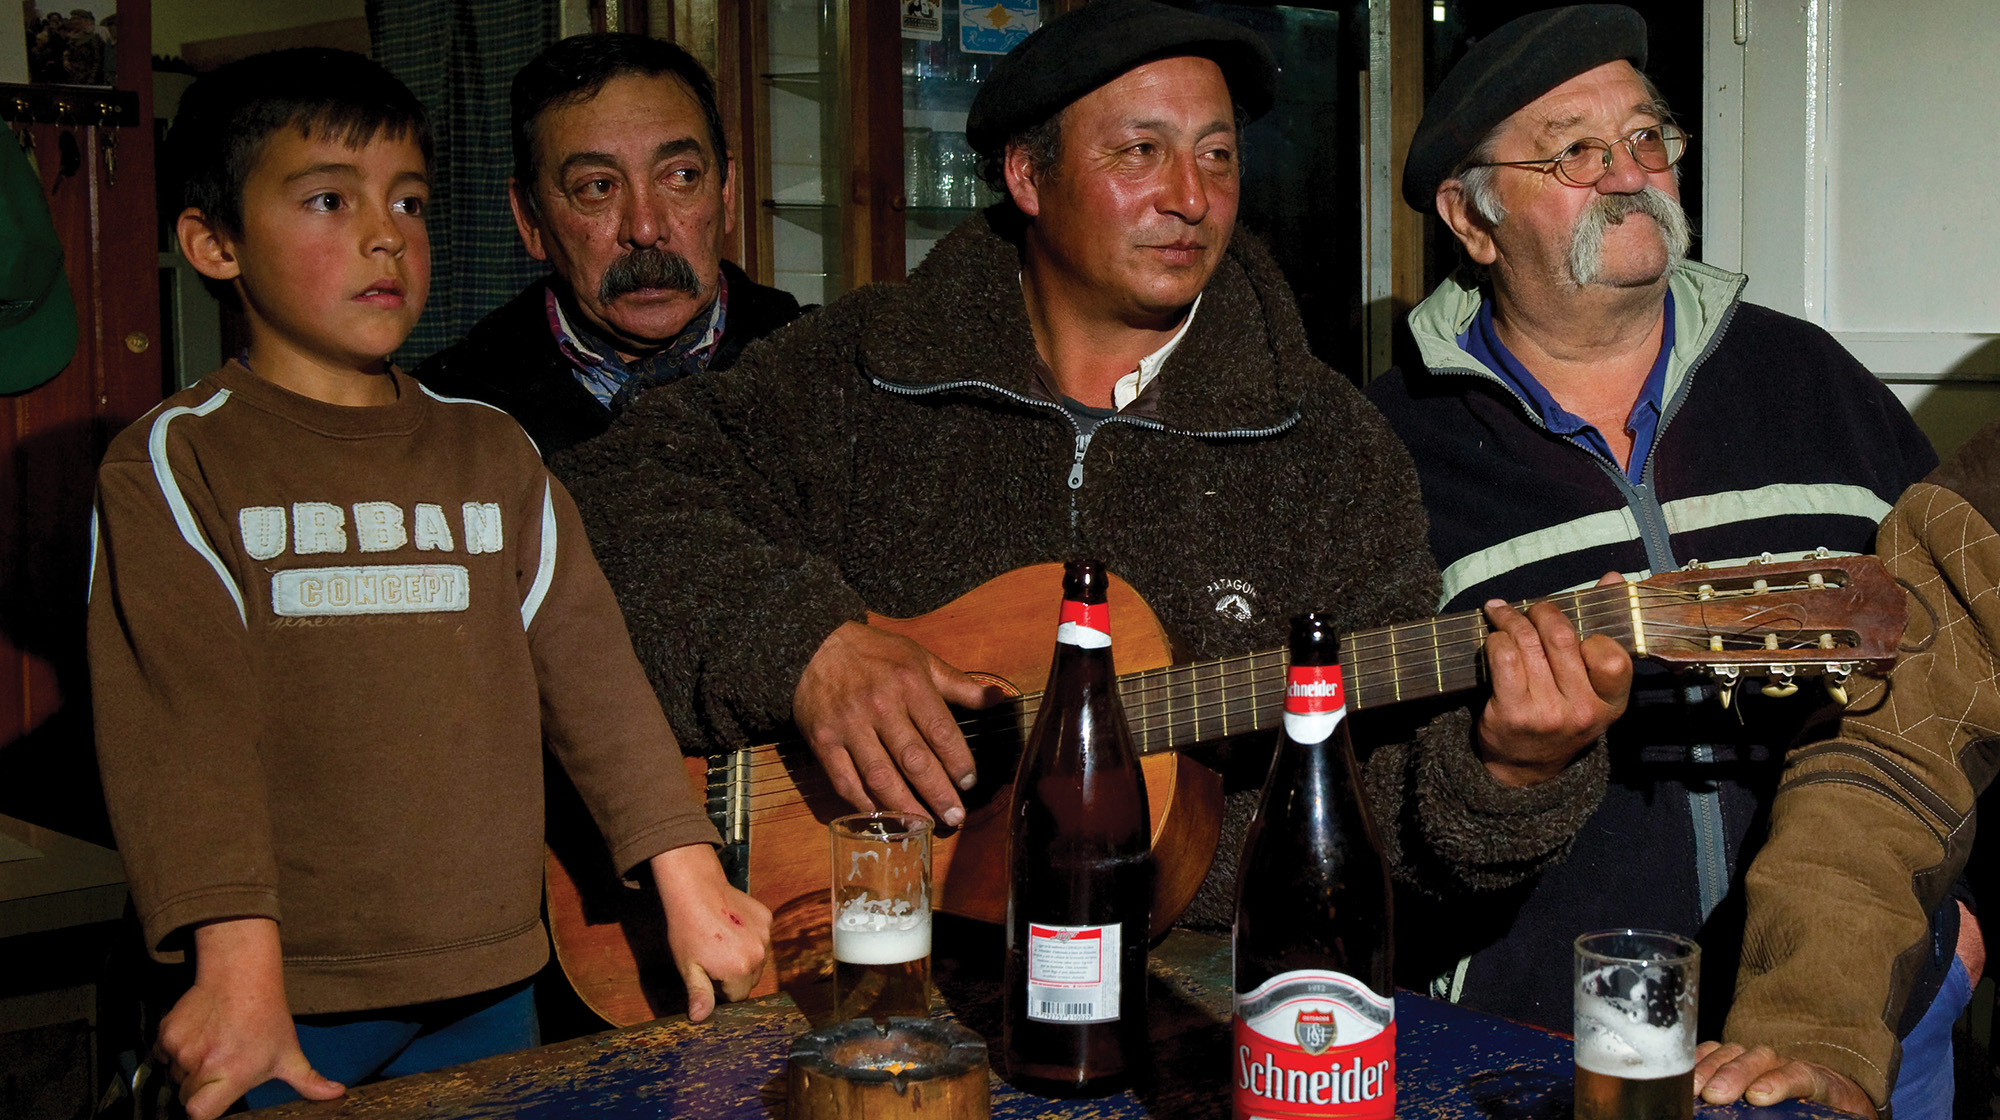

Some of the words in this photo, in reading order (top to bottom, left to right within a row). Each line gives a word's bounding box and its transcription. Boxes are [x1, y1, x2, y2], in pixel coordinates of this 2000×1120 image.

[239, 501, 503, 561] URBAN
[299, 574, 455, 608] CONCEPT
[1238, 1045, 1389, 1105] Schneider
